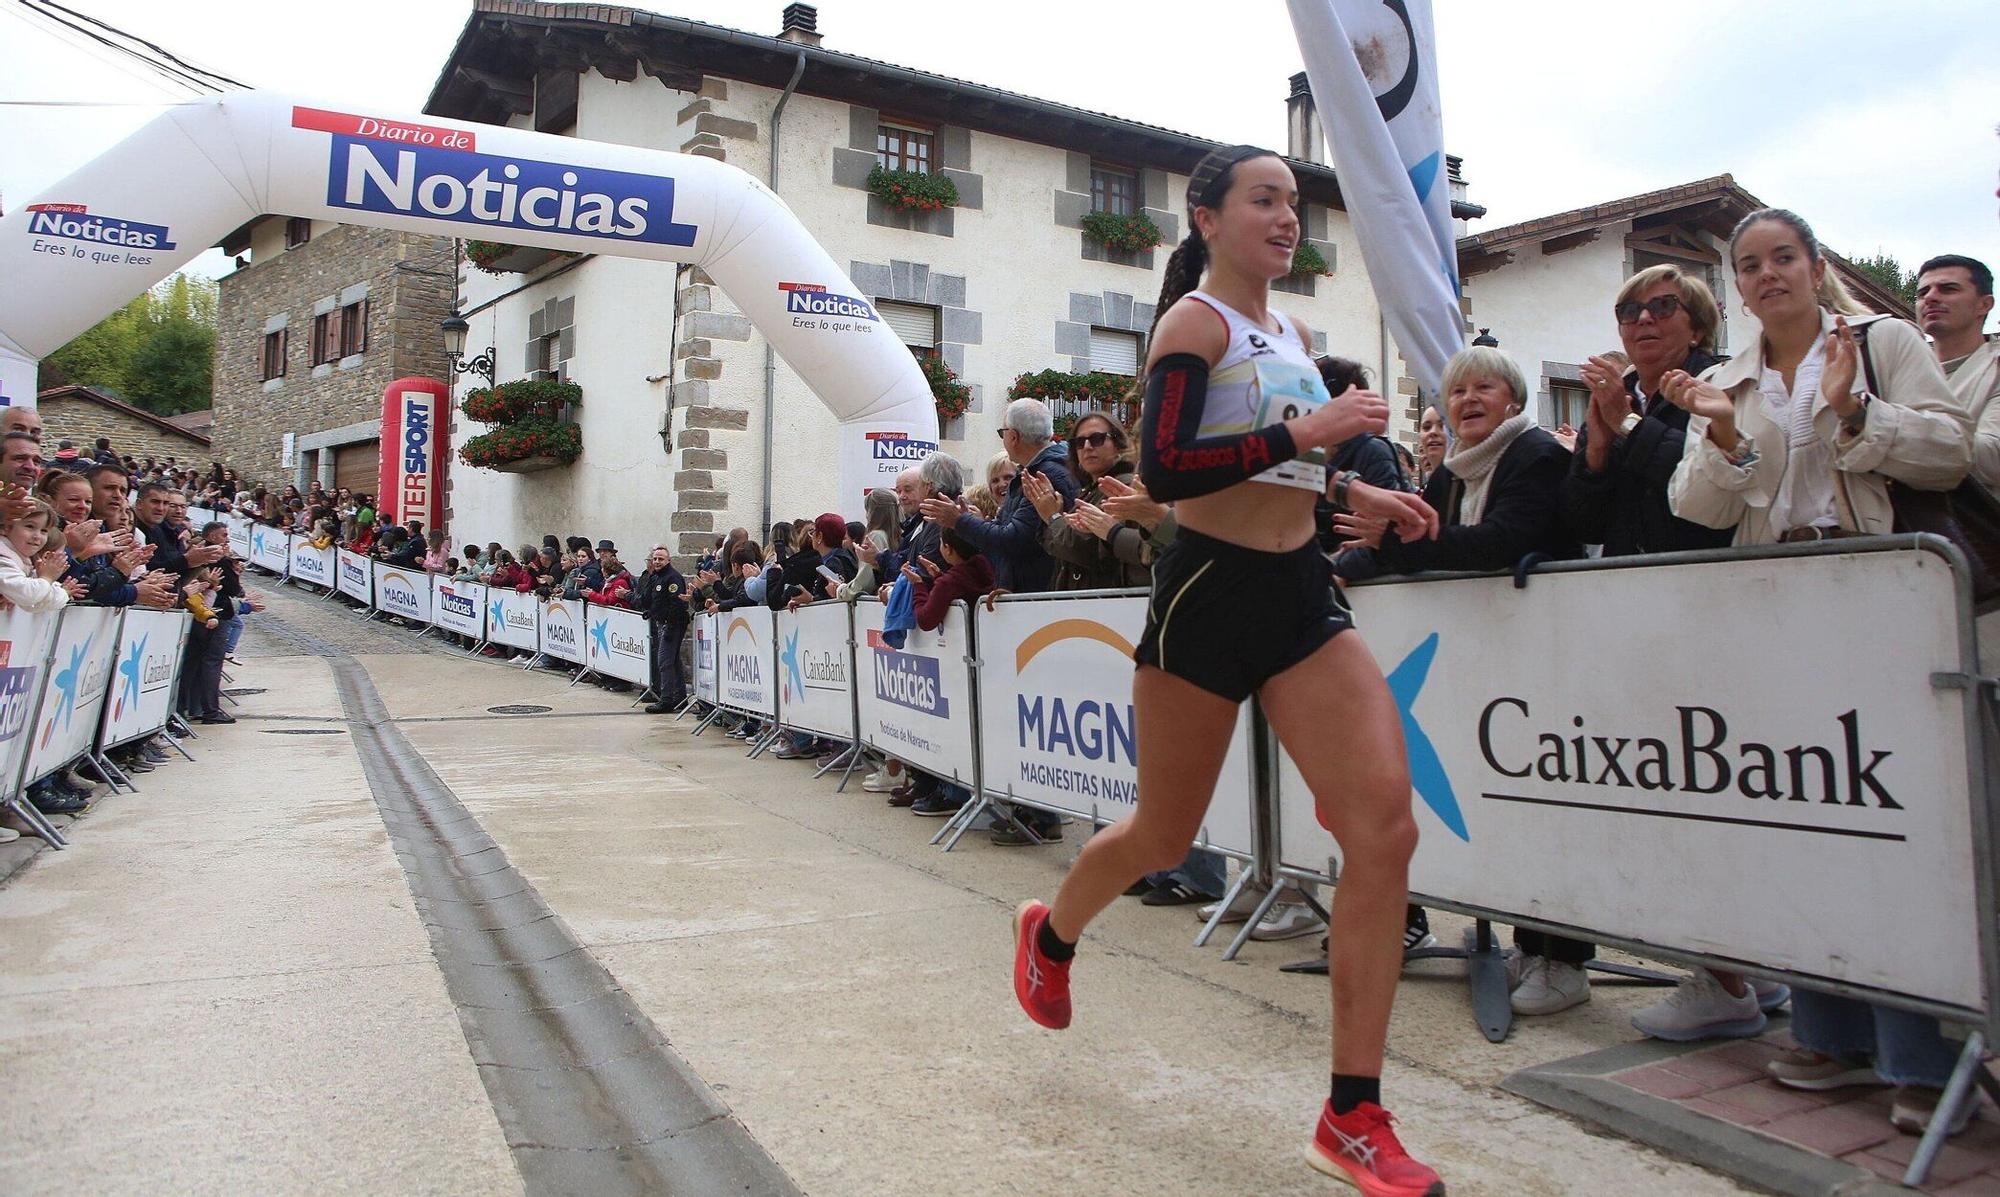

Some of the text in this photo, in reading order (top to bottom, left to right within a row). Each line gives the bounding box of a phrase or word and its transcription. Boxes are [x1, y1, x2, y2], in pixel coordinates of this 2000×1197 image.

[358, 118, 470, 149] Diario de
[345, 143, 649, 238] Noticias
[43, 204, 85, 214] Diario de
[34, 213, 158, 248] Noticias
[33, 239, 153, 265] Eres lo que lees
[791, 293, 870, 318] Noticias
[792, 317, 872, 333] Eres lo que lees
[403, 400, 429, 526] TERSPORT
[877, 441, 934, 460] Notici
[878, 463, 899, 473] Eres
[297, 555, 324, 574] MAGNA
[384, 586, 419, 608] MAGNA
[442, 594, 471, 615] Noticias
[506, 609, 534, 627] CaixaBank
[547, 623, 576, 645] MAGNA
[611, 632, 646, 656] CaixaBank
[727, 654, 761, 685] MAGNA
[803, 650, 846, 683] CaixaBank
[876, 654, 936, 711] Noticias
[1018, 693, 1138, 767] MAGN
[1478, 697, 1905, 810] CaixaBank
[1020, 761, 1138, 805] MAGNESITAS NAVA
